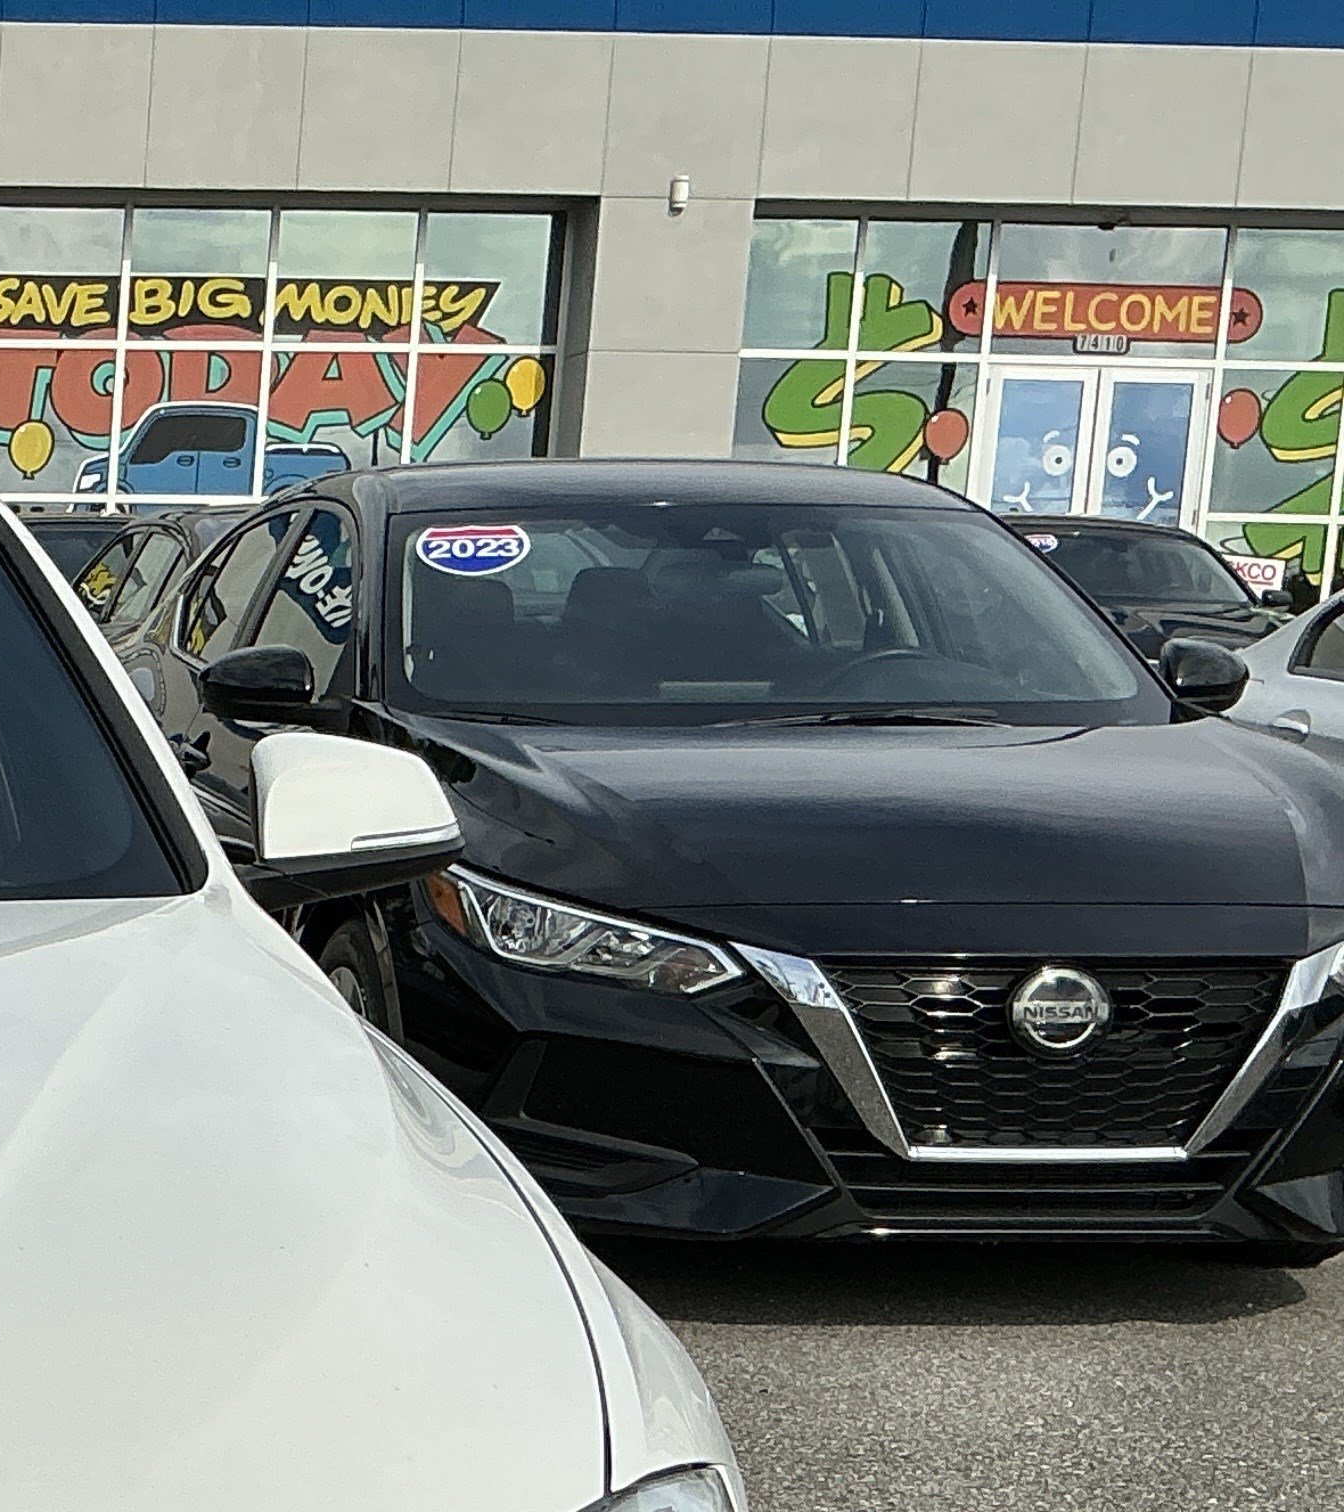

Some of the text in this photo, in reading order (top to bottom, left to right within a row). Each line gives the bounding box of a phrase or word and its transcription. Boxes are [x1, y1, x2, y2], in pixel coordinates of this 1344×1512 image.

[129, 278, 253, 323] BIG
[260, 283, 488, 333] MONEY
[992, 289, 1217, 334] WELCOME
[1079, 334, 1124, 351] 7410
[428, 538, 521, 558] 2023
[1023, 1005, 1098, 1019] NISSAN
